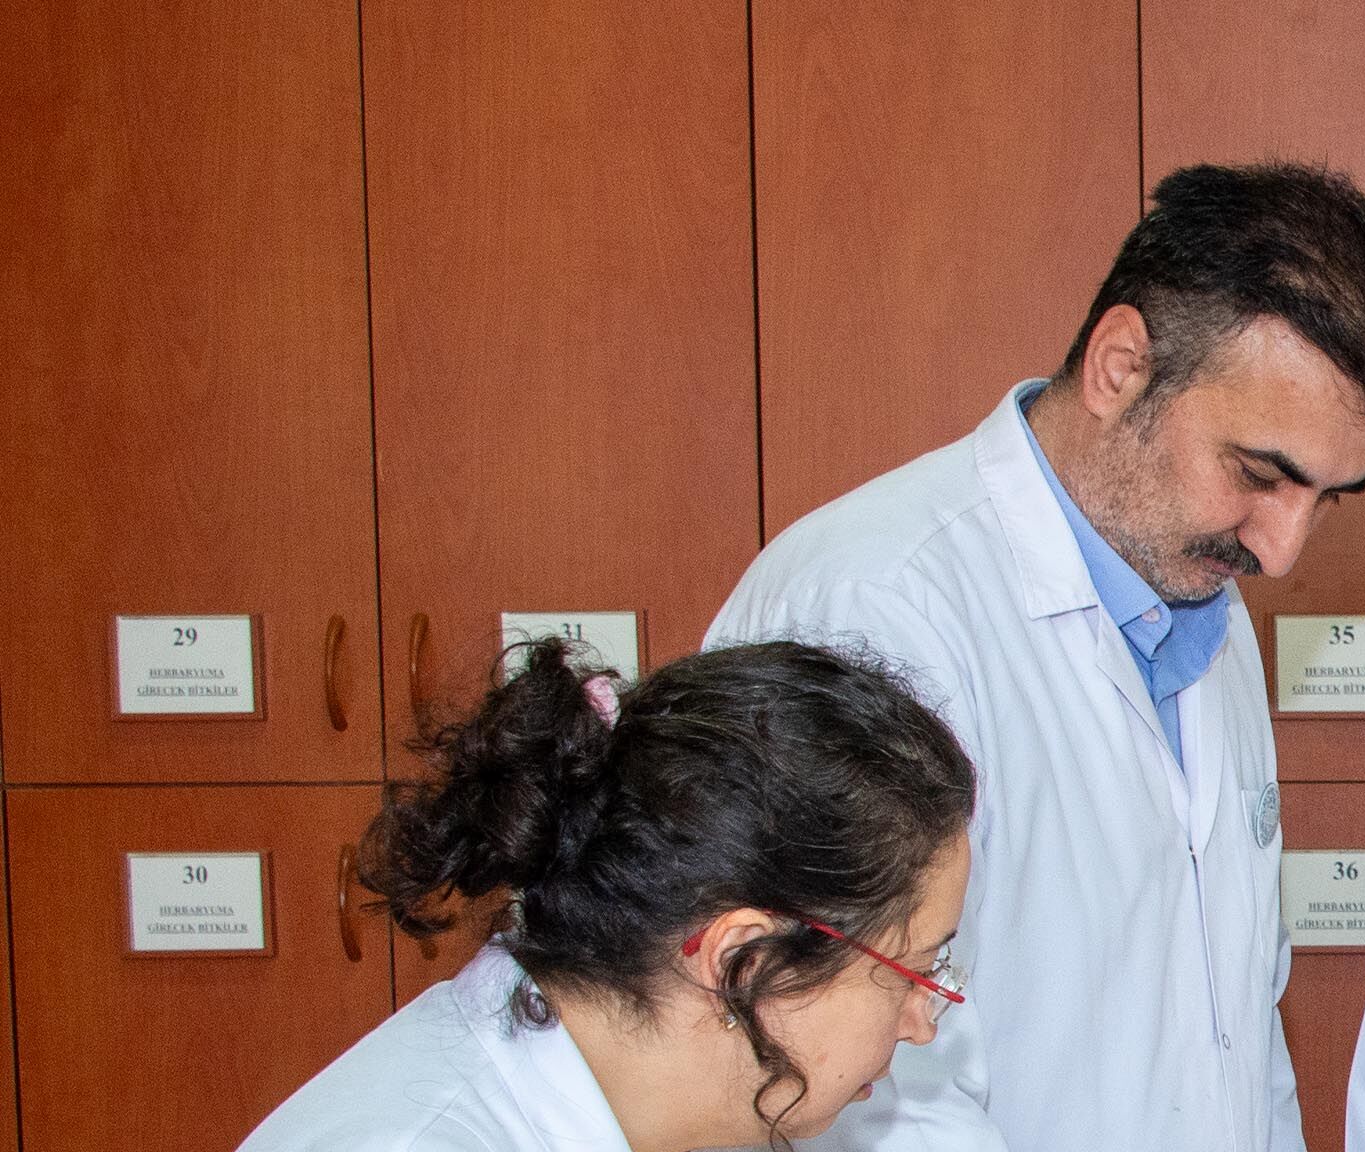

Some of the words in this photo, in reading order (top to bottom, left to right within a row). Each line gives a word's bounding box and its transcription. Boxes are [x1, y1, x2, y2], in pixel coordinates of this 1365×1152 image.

[173, 627, 198, 646] 29
[1328, 625, 1355, 645] 35
[149, 668, 226, 679] HERBARYUMA
[182, 865, 208, 884] 30
[1333, 861, 1359, 880] 36
[160, 906, 236, 917] HERBARYUMA
